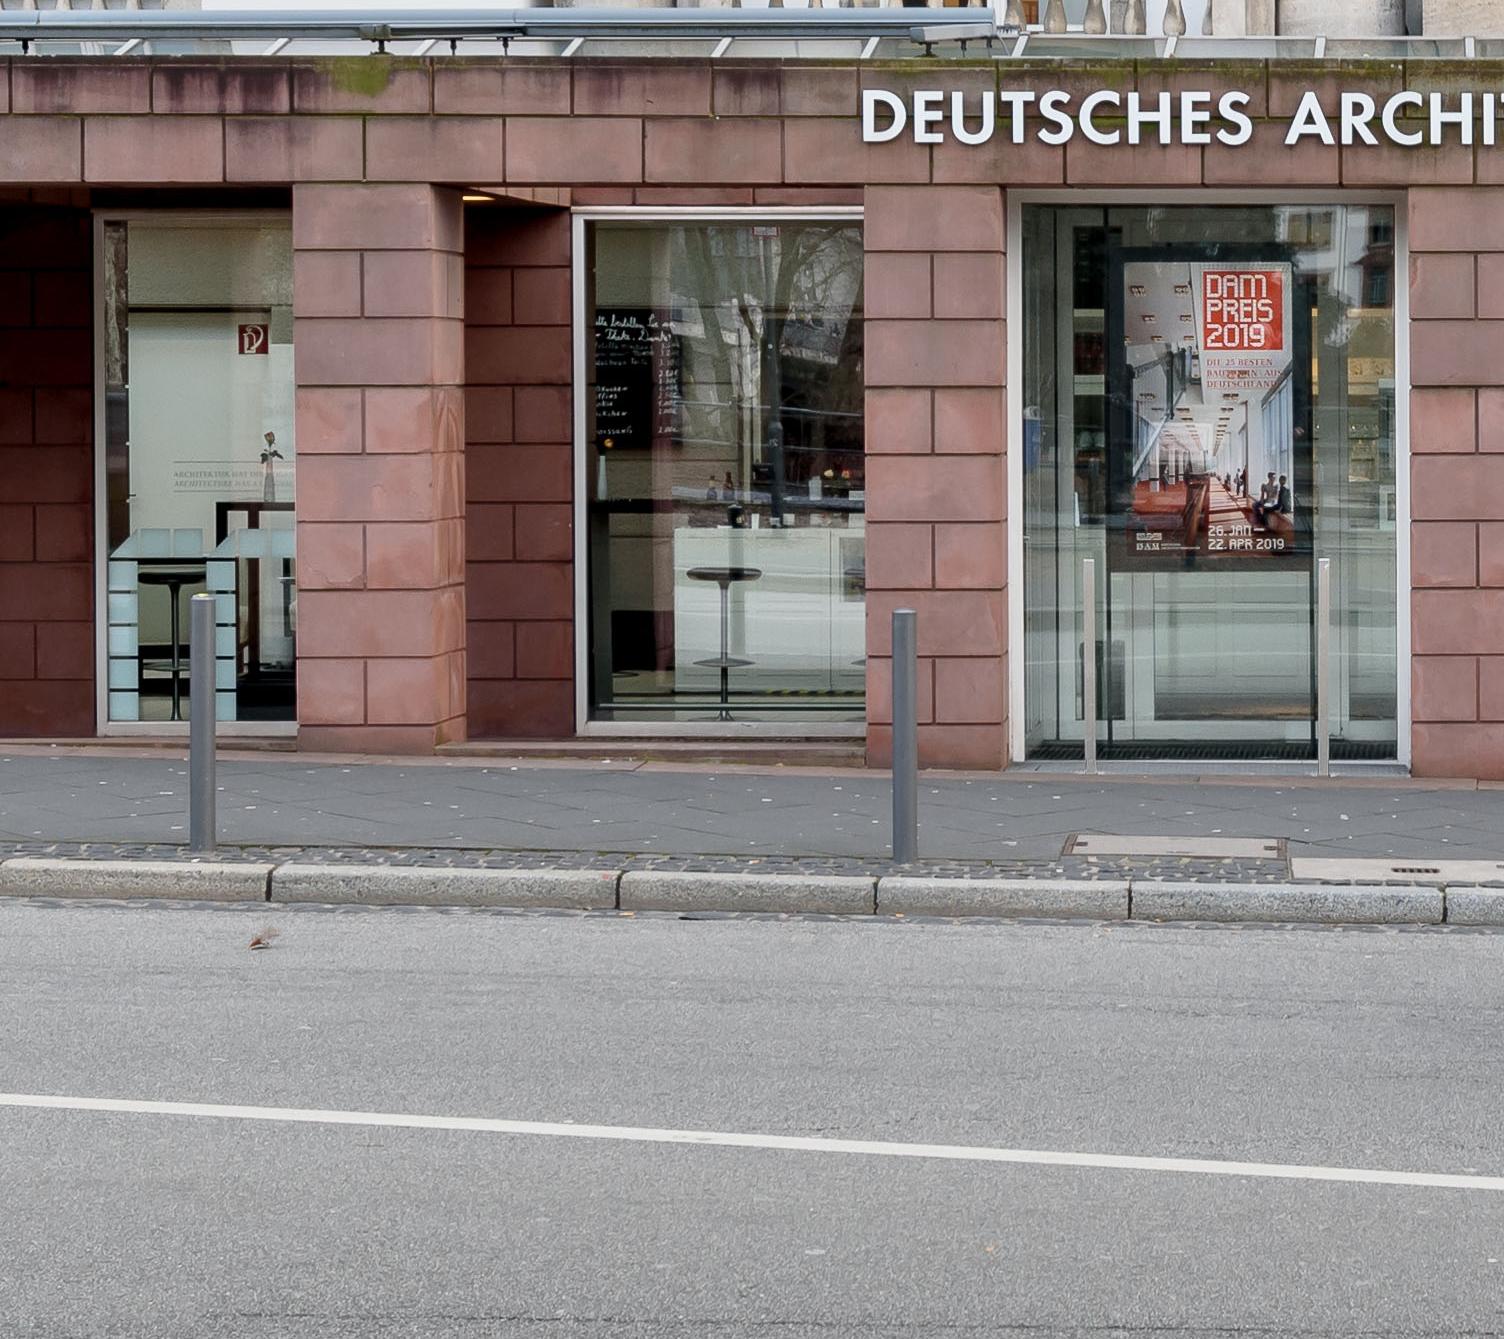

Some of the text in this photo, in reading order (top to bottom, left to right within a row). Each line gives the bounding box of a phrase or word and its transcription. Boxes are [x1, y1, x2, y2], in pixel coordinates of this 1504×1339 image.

[862, 90, 1253, 147] DEUTSCHES
[1206, 274, 1266, 298] DAM
[1206, 299, 1273, 323] PREIS
[1206, 323, 1266, 348] 2019
[1207, 358, 1220, 366] DIE
[1238, 358, 1273, 366] BESTEN
[1207, 380, 1278, 388] DEUTSCHLAND
[1208, 525, 1227, 537] 26.
[1229, 525, 1252, 537] JAN
[1208, 538, 1227, 550] 22.
[1229, 538, 1252, 550] APR
[1256, 538, 1285, 550] 2019
